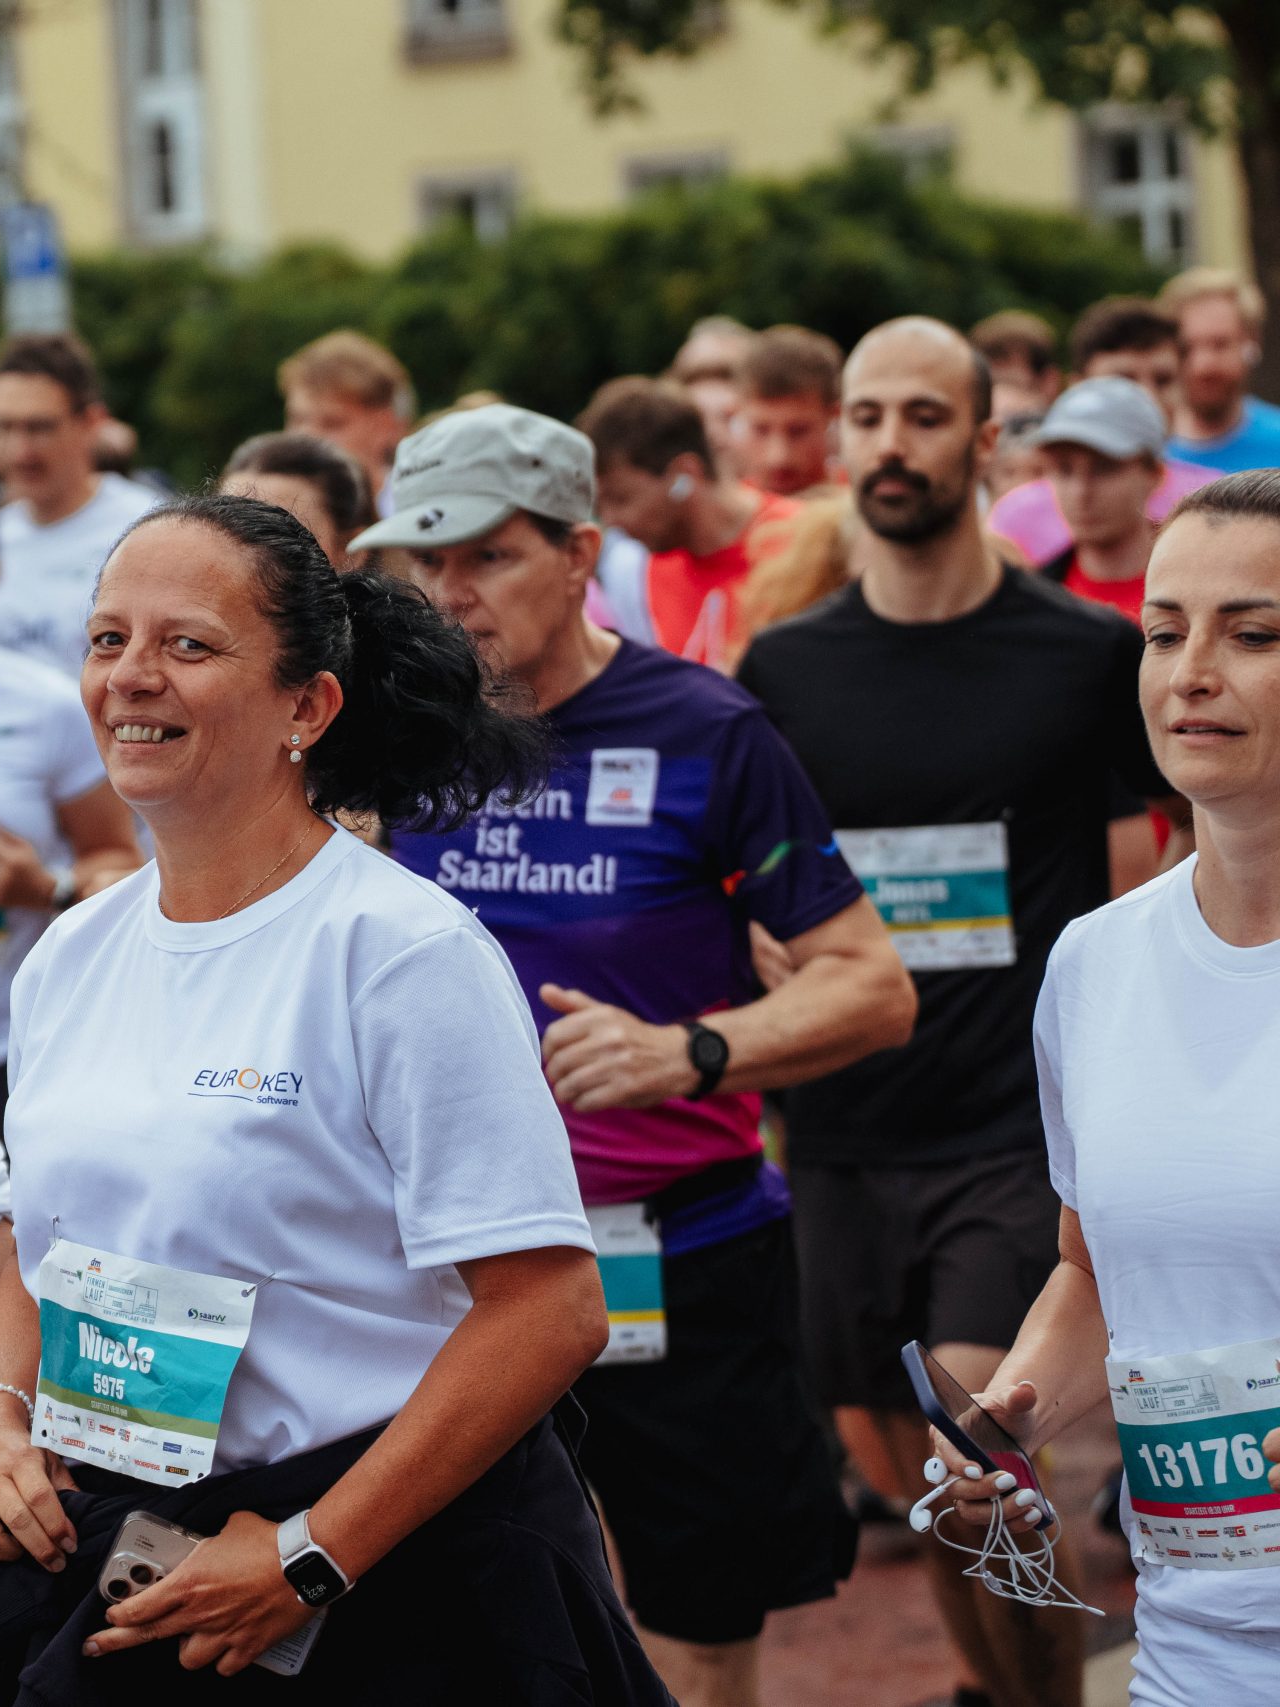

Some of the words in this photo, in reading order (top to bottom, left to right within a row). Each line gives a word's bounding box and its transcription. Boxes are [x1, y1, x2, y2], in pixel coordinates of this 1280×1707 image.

[476, 817, 522, 858] ist
[436, 851, 617, 893] Saarland!
[193, 1068, 303, 1093] EUROKEY
[256, 1095, 299, 1107] Software
[85, 1287, 104, 1302] LAUF
[86, 1276, 106, 1289] FIRMEN
[79, 1322, 155, 1374] Nicole
[93, 1372, 126, 1400] 5975
[1133, 1386, 1157, 1396] FIRMEN
[1136, 1396, 1159, 1410] LAUF
[1138, 1433, 1265, 1488] 13176
